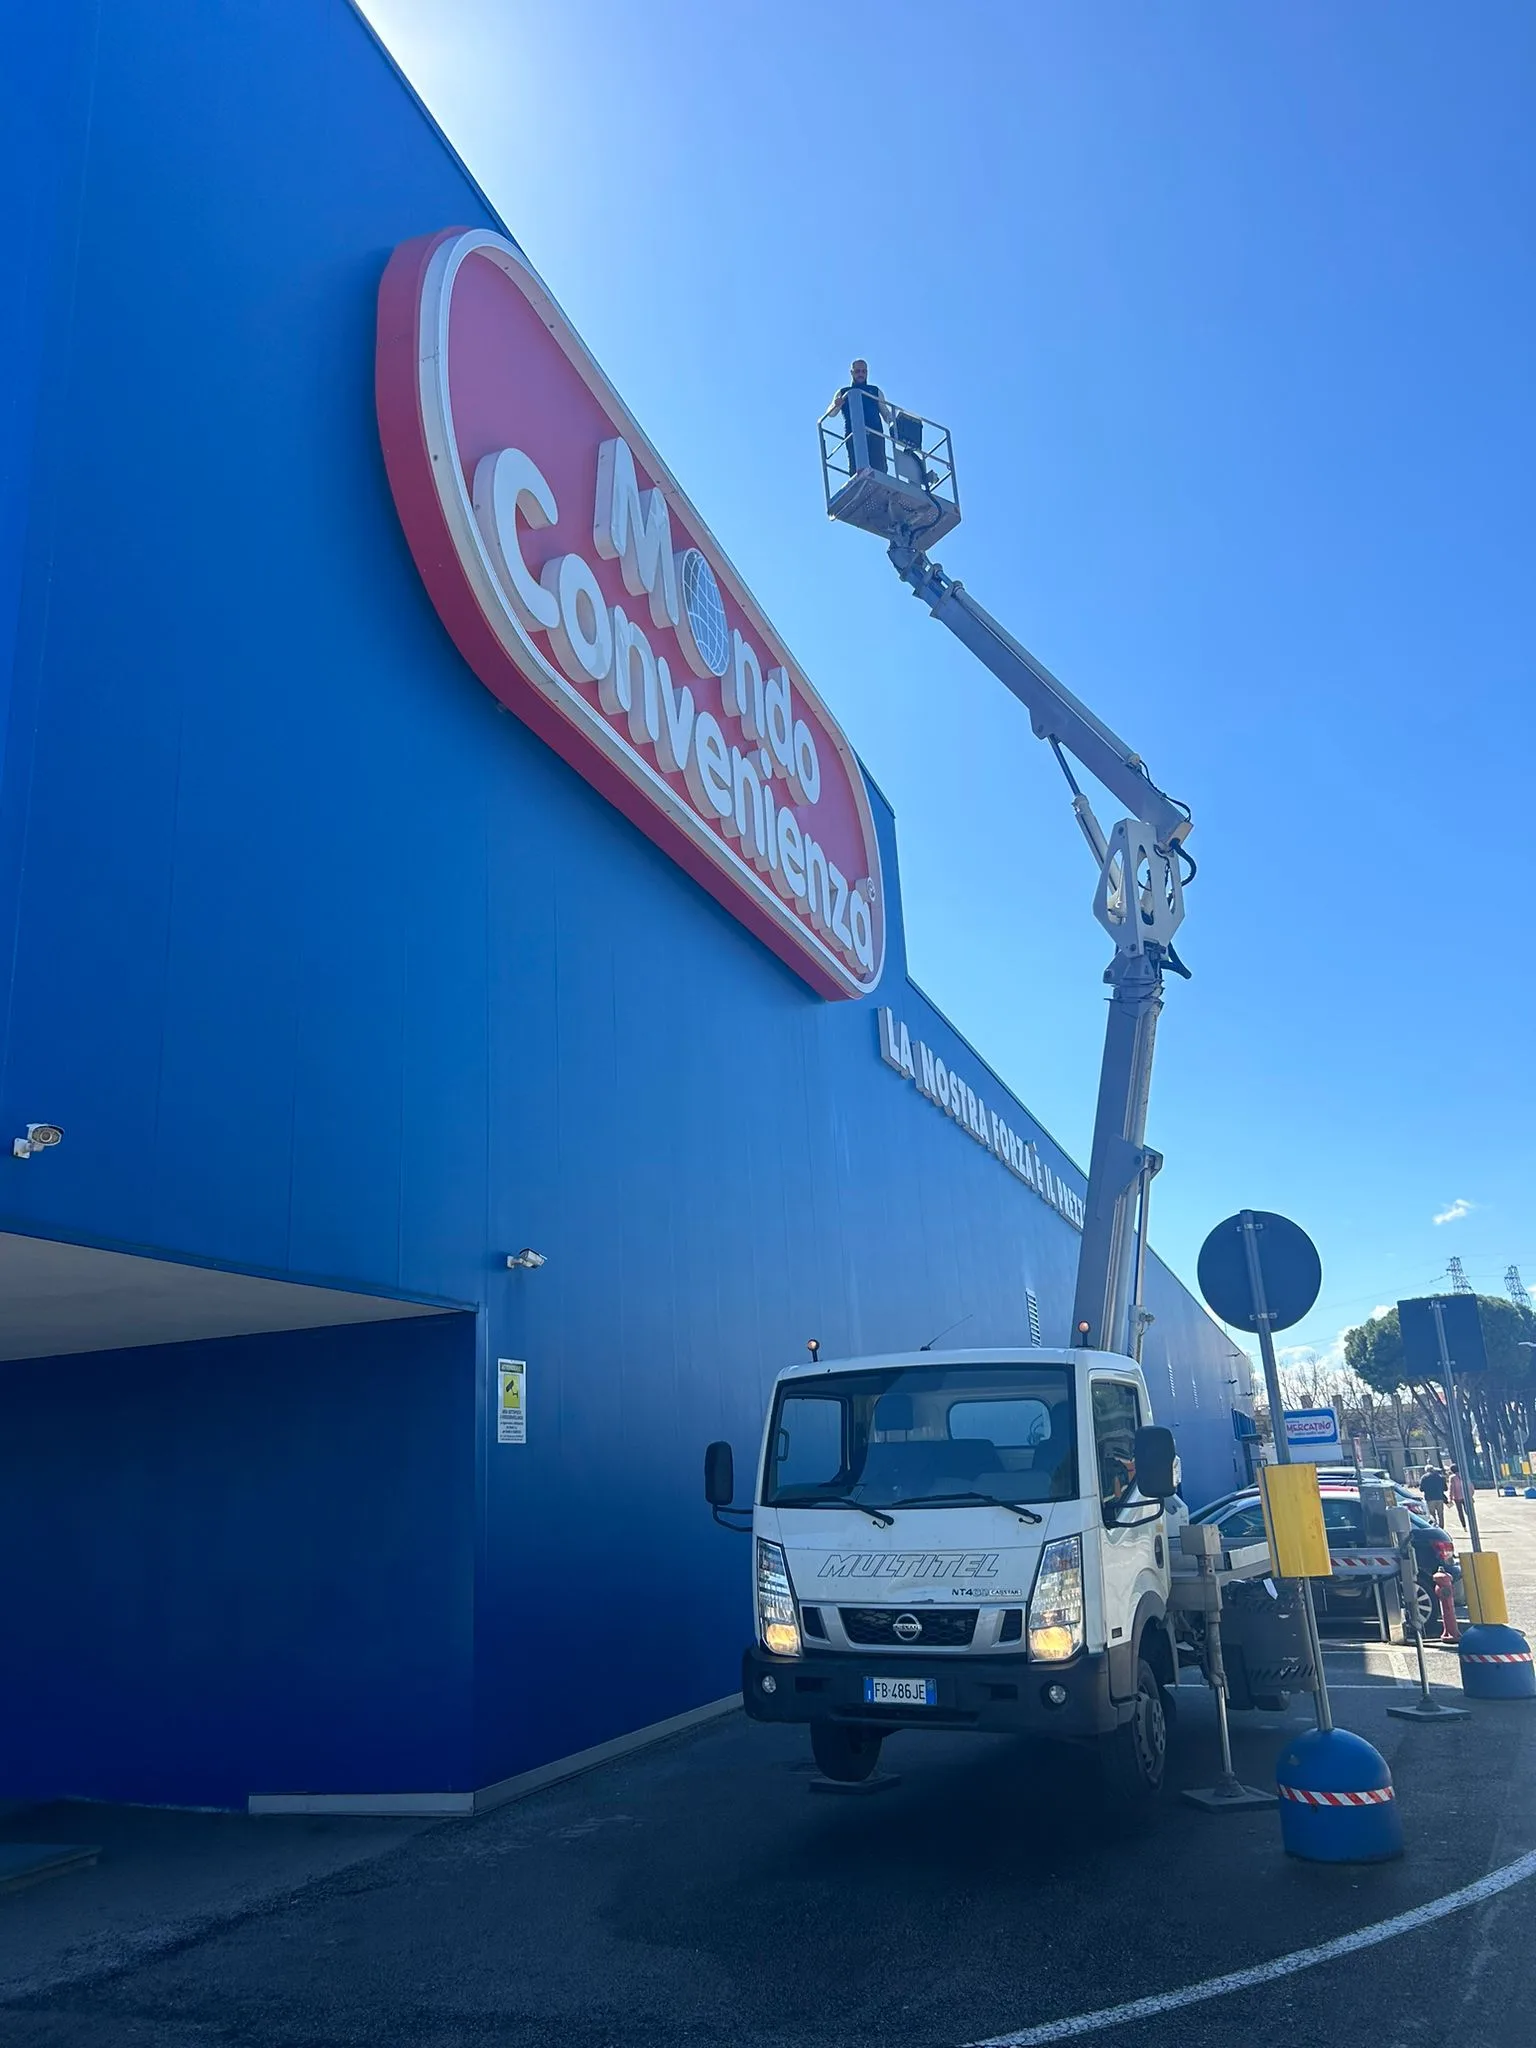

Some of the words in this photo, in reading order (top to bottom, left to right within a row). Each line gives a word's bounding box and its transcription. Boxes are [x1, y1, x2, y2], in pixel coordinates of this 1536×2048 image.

[477, 448, 874, 974] Convenienza
[597, 437, 821, 805] Mondo
[881, 1006, 915, 1079] LA
[917, 1040, 990, 1145] NOSTRA
[990, 1110, 1035, 1185] FORZA
[1043, 1164, 1056, 1204] IL
[1286, 1421, 1331, 1432] MERCATINO
[817, 1554, 999, 1577] MULTITEL
